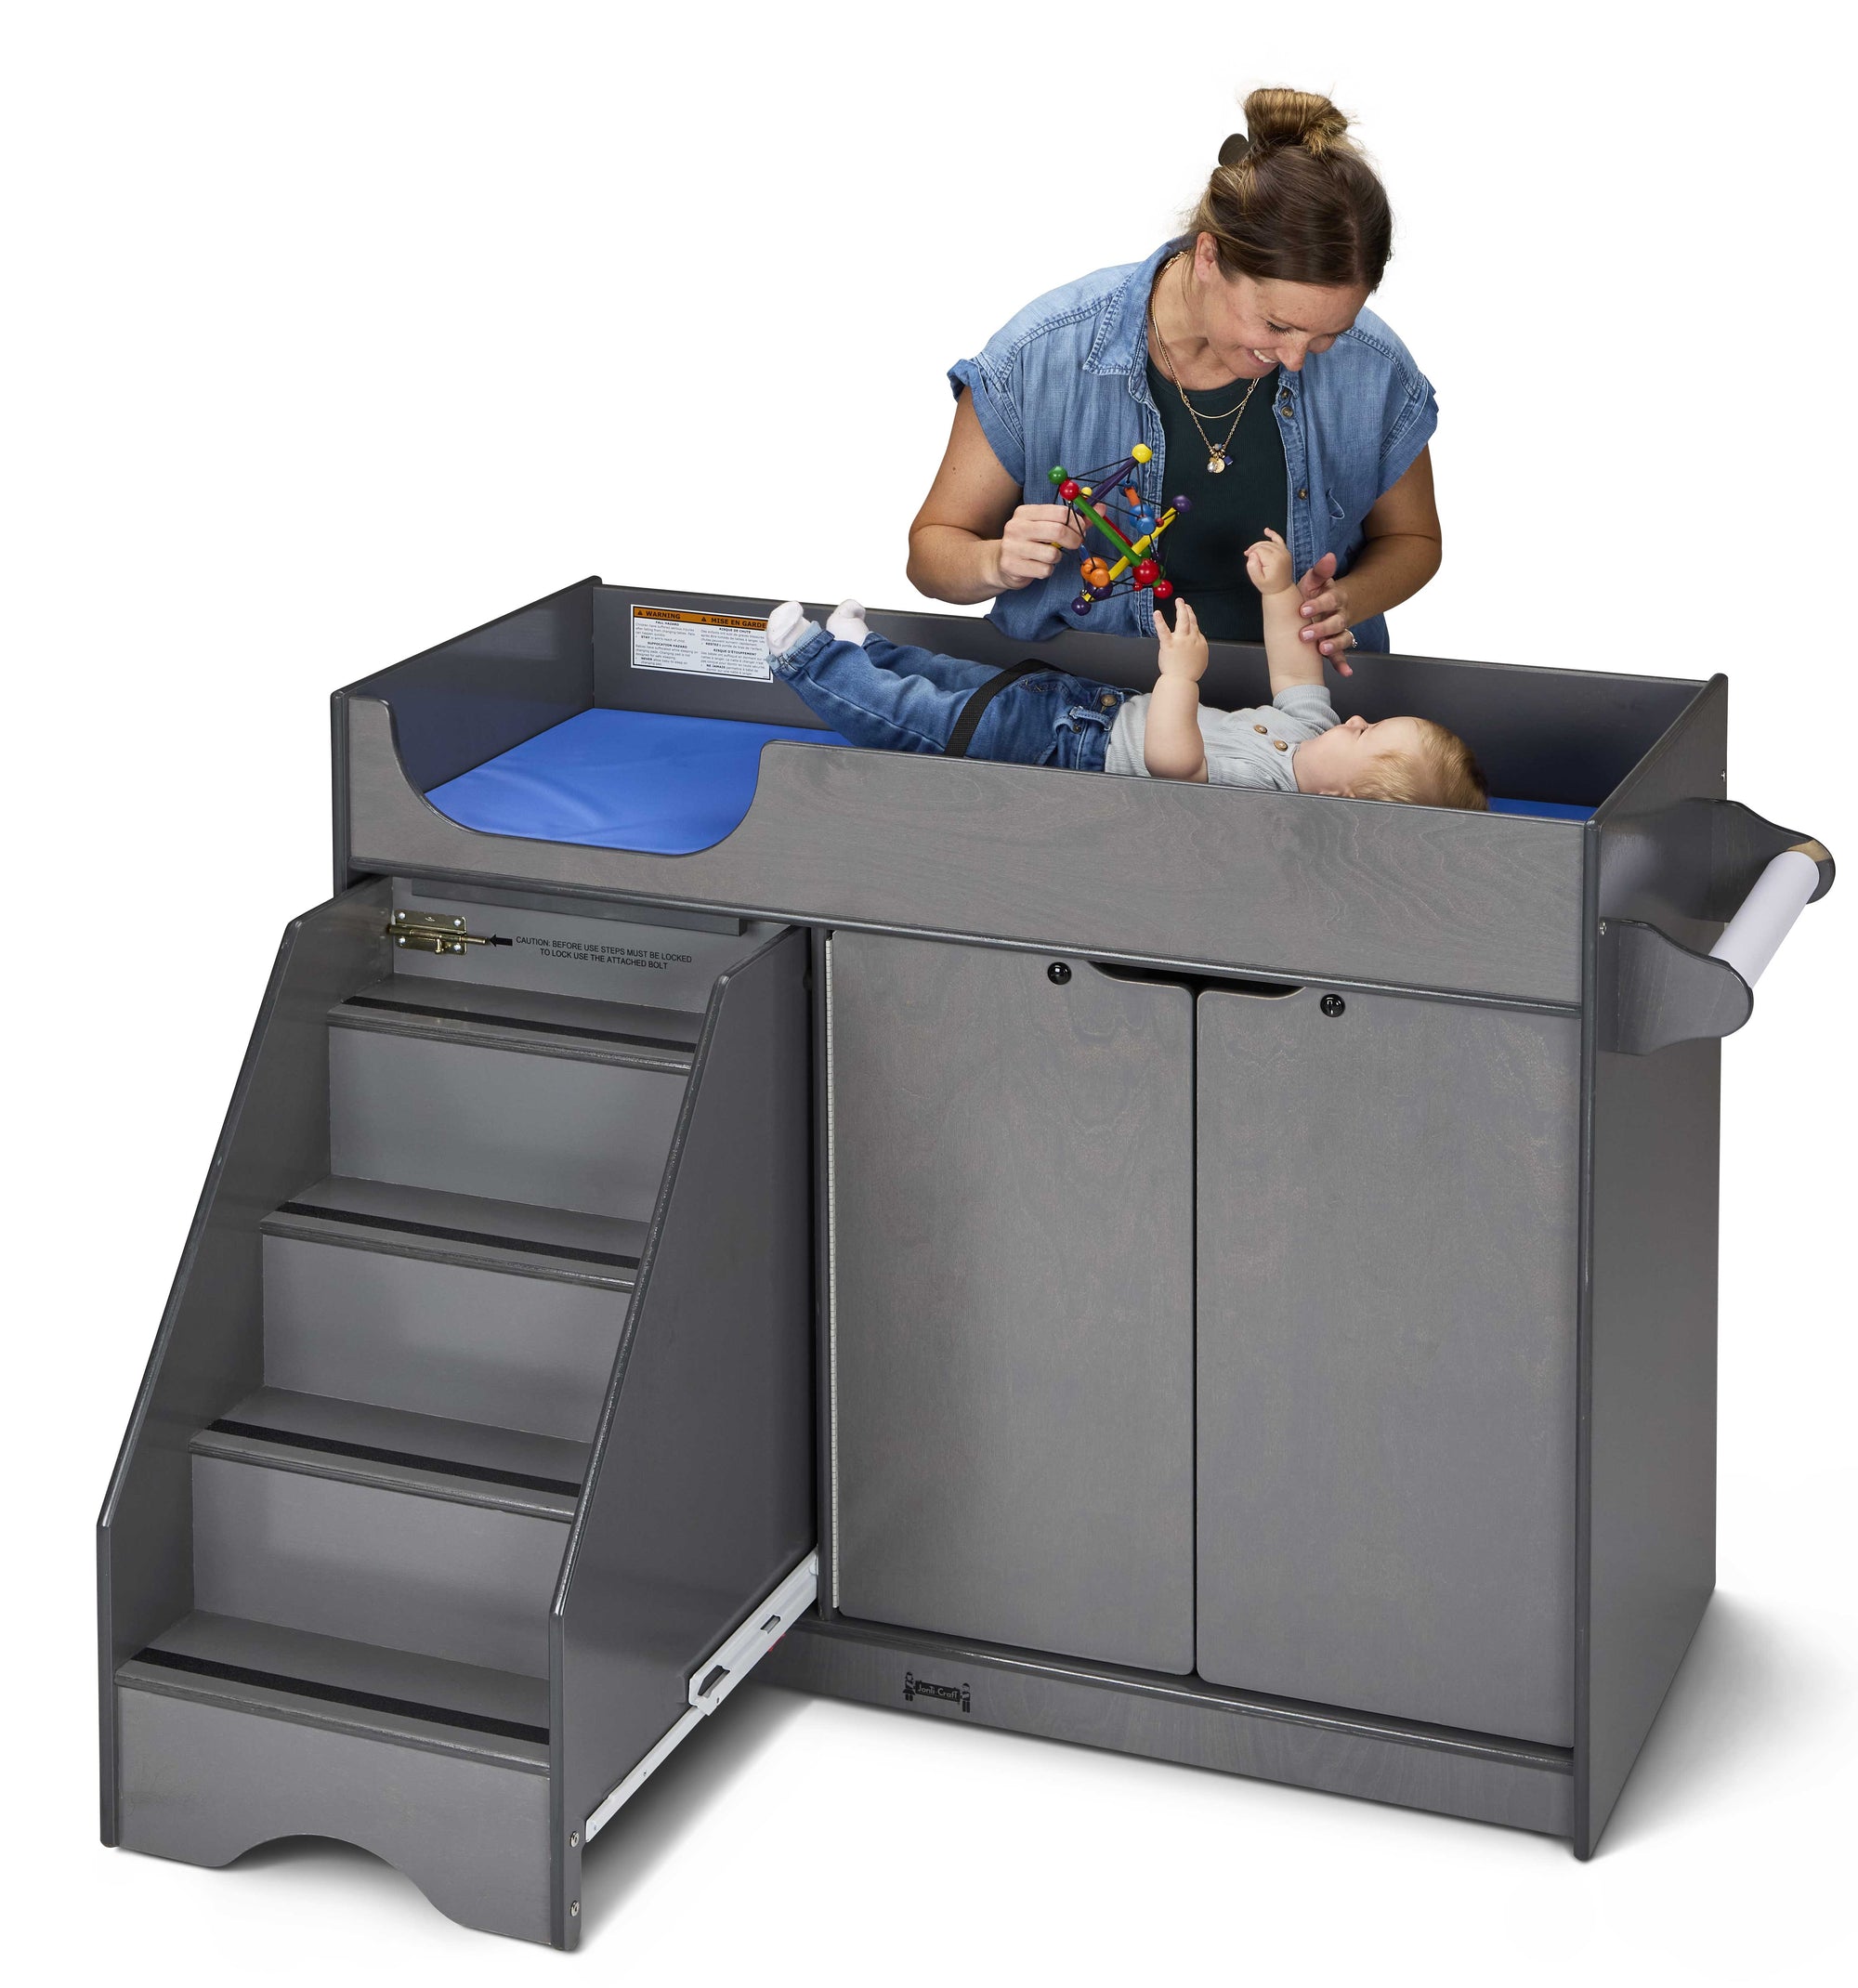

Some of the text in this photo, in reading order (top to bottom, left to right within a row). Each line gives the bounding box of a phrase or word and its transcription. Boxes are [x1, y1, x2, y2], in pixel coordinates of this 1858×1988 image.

[646, 610, 681, 620] WARNING
[711, 617, 729, 625] MISE
[741, 621, 766, 629] GARDE
[516, 935, 692, 963] CAUTION: BEFORE USE STEPS MUST BE LOCKED
[540, 948, 668, 970] TO LOCK USE THE ATTACHED BOLT
